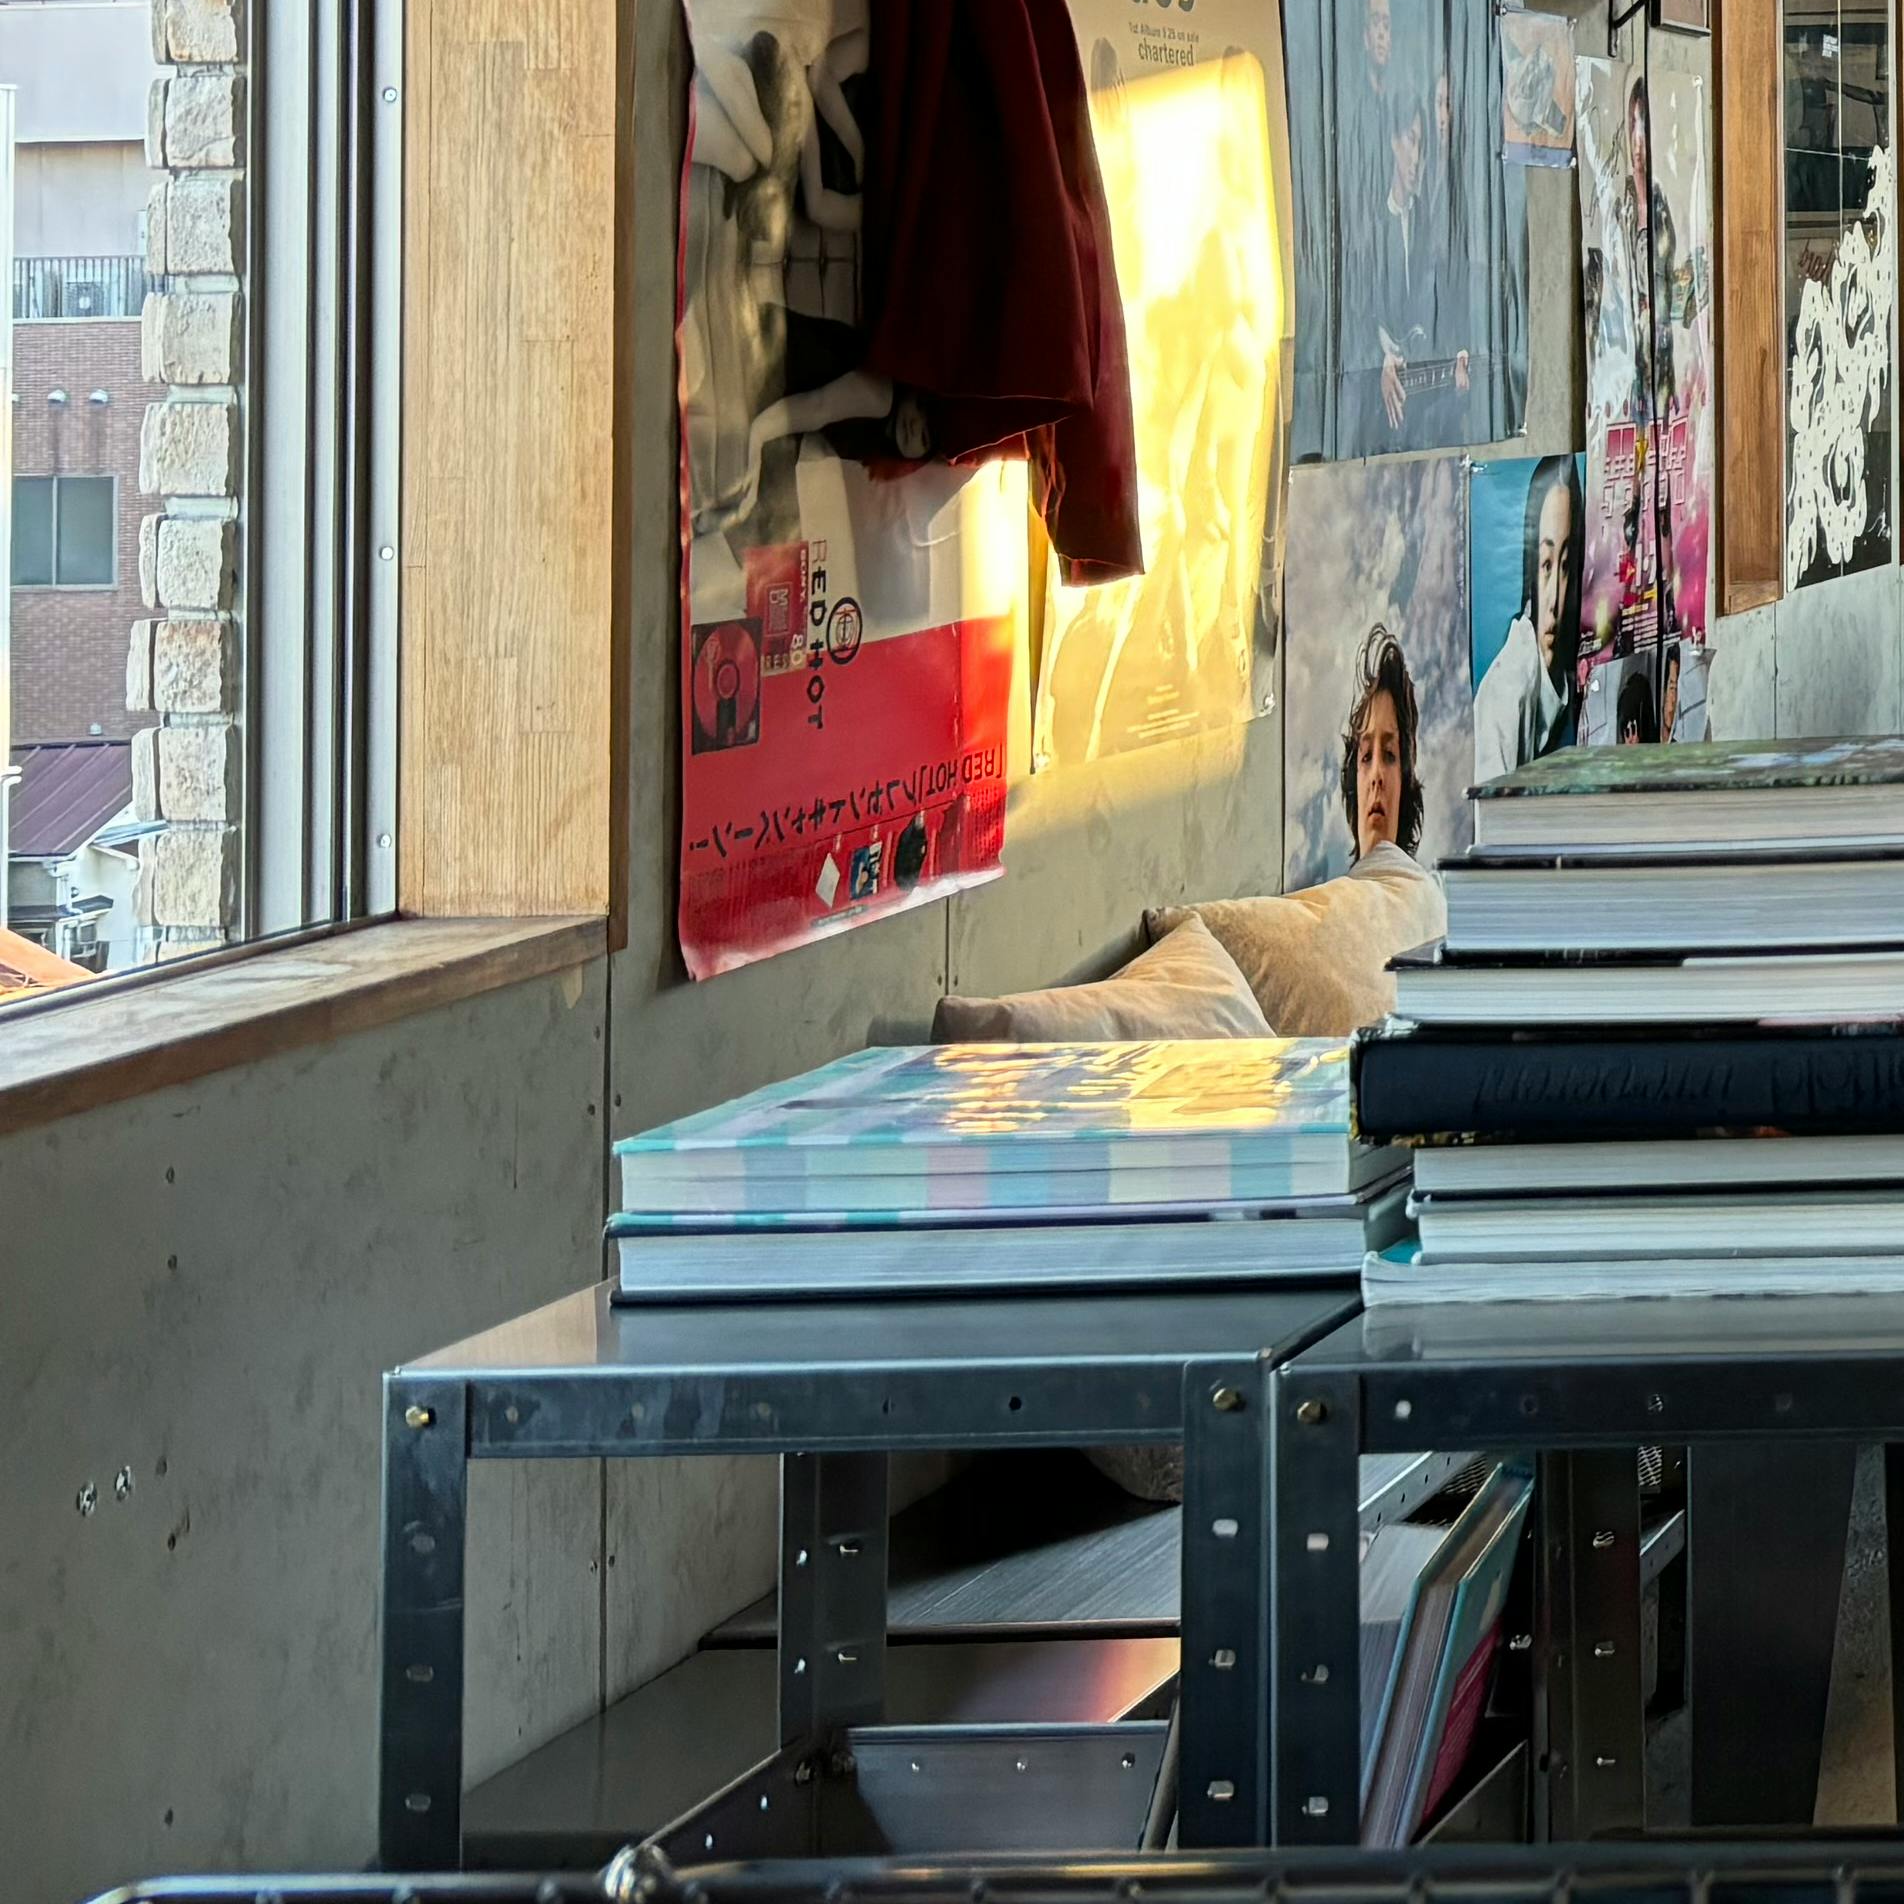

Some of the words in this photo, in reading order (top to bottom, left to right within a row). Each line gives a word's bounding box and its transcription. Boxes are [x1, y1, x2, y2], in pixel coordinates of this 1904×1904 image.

[1138, 37, 1194, 67] chartered
[808, 540, 828, 626] RED
[807, 639, 825, 730] HOT
